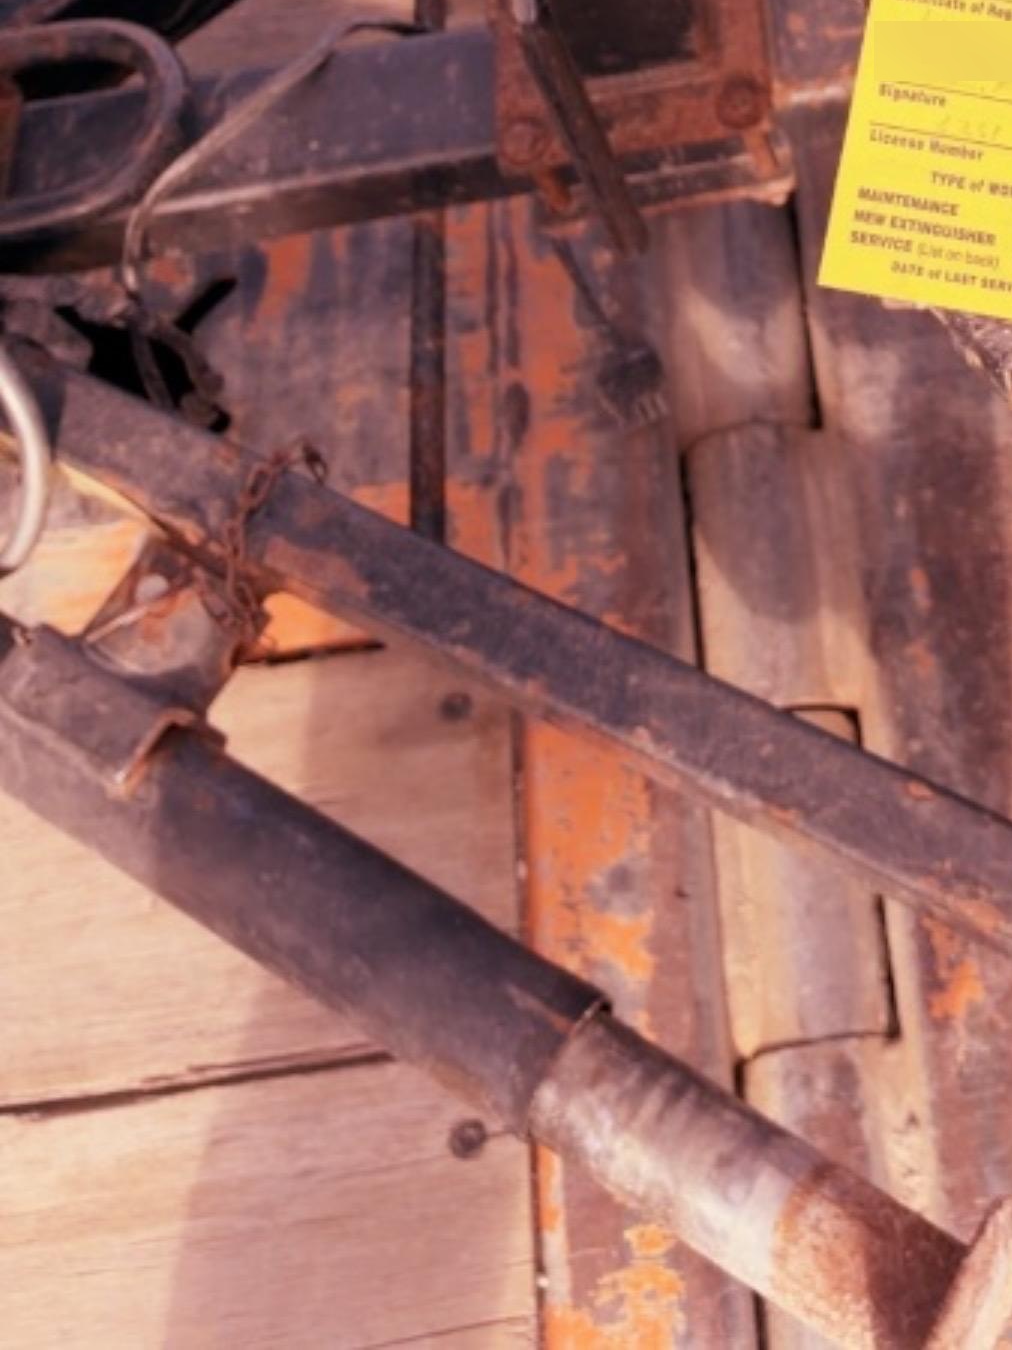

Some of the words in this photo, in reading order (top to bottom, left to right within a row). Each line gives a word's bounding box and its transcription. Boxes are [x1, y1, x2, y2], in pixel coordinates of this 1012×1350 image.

[970, 0, 985, 13] of
[878, 83, 947, 108] Signature
[869, 129, 925, 151] License
[929, 138, 985, 161] Number
[931, 170, 966, 189] TYPE
[969, 179, 984, 192] of
[857, 187, 960, 217] MAINTENANCE
[853, 208, 886, 225] NEW
[890, 214, 996, 246] EXTINGUISHER
[850, 230, 913, 253] SERVICE
[890, 260, 924, 277] DATE
[928, 267, 943, 280] of
[945, 269, 977, 286] LAST
